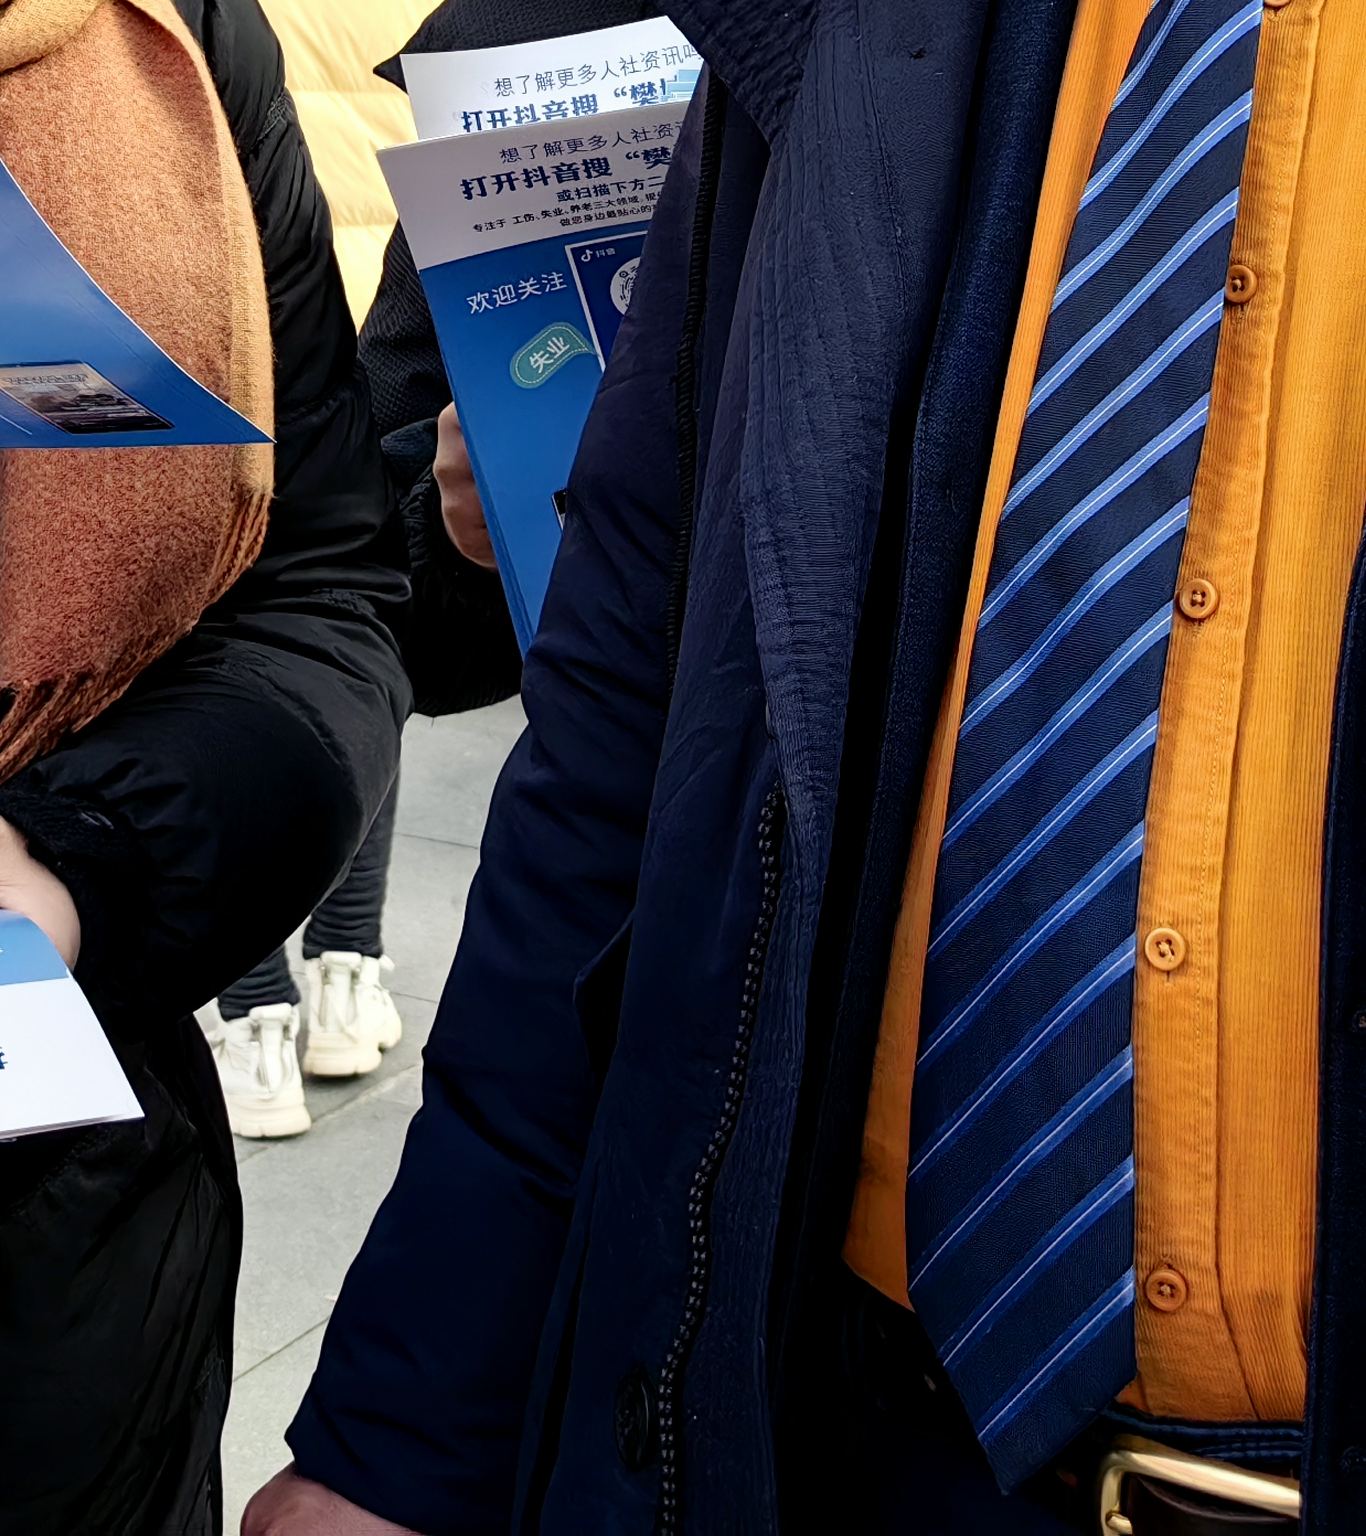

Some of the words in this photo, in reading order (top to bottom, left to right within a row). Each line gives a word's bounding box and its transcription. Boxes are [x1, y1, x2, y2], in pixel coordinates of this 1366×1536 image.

[460, 157, 613, 201] 打开抖音搜
[466, 271, 568, 314] 欢迎关注
[528, 335, 571, 374] 失业
